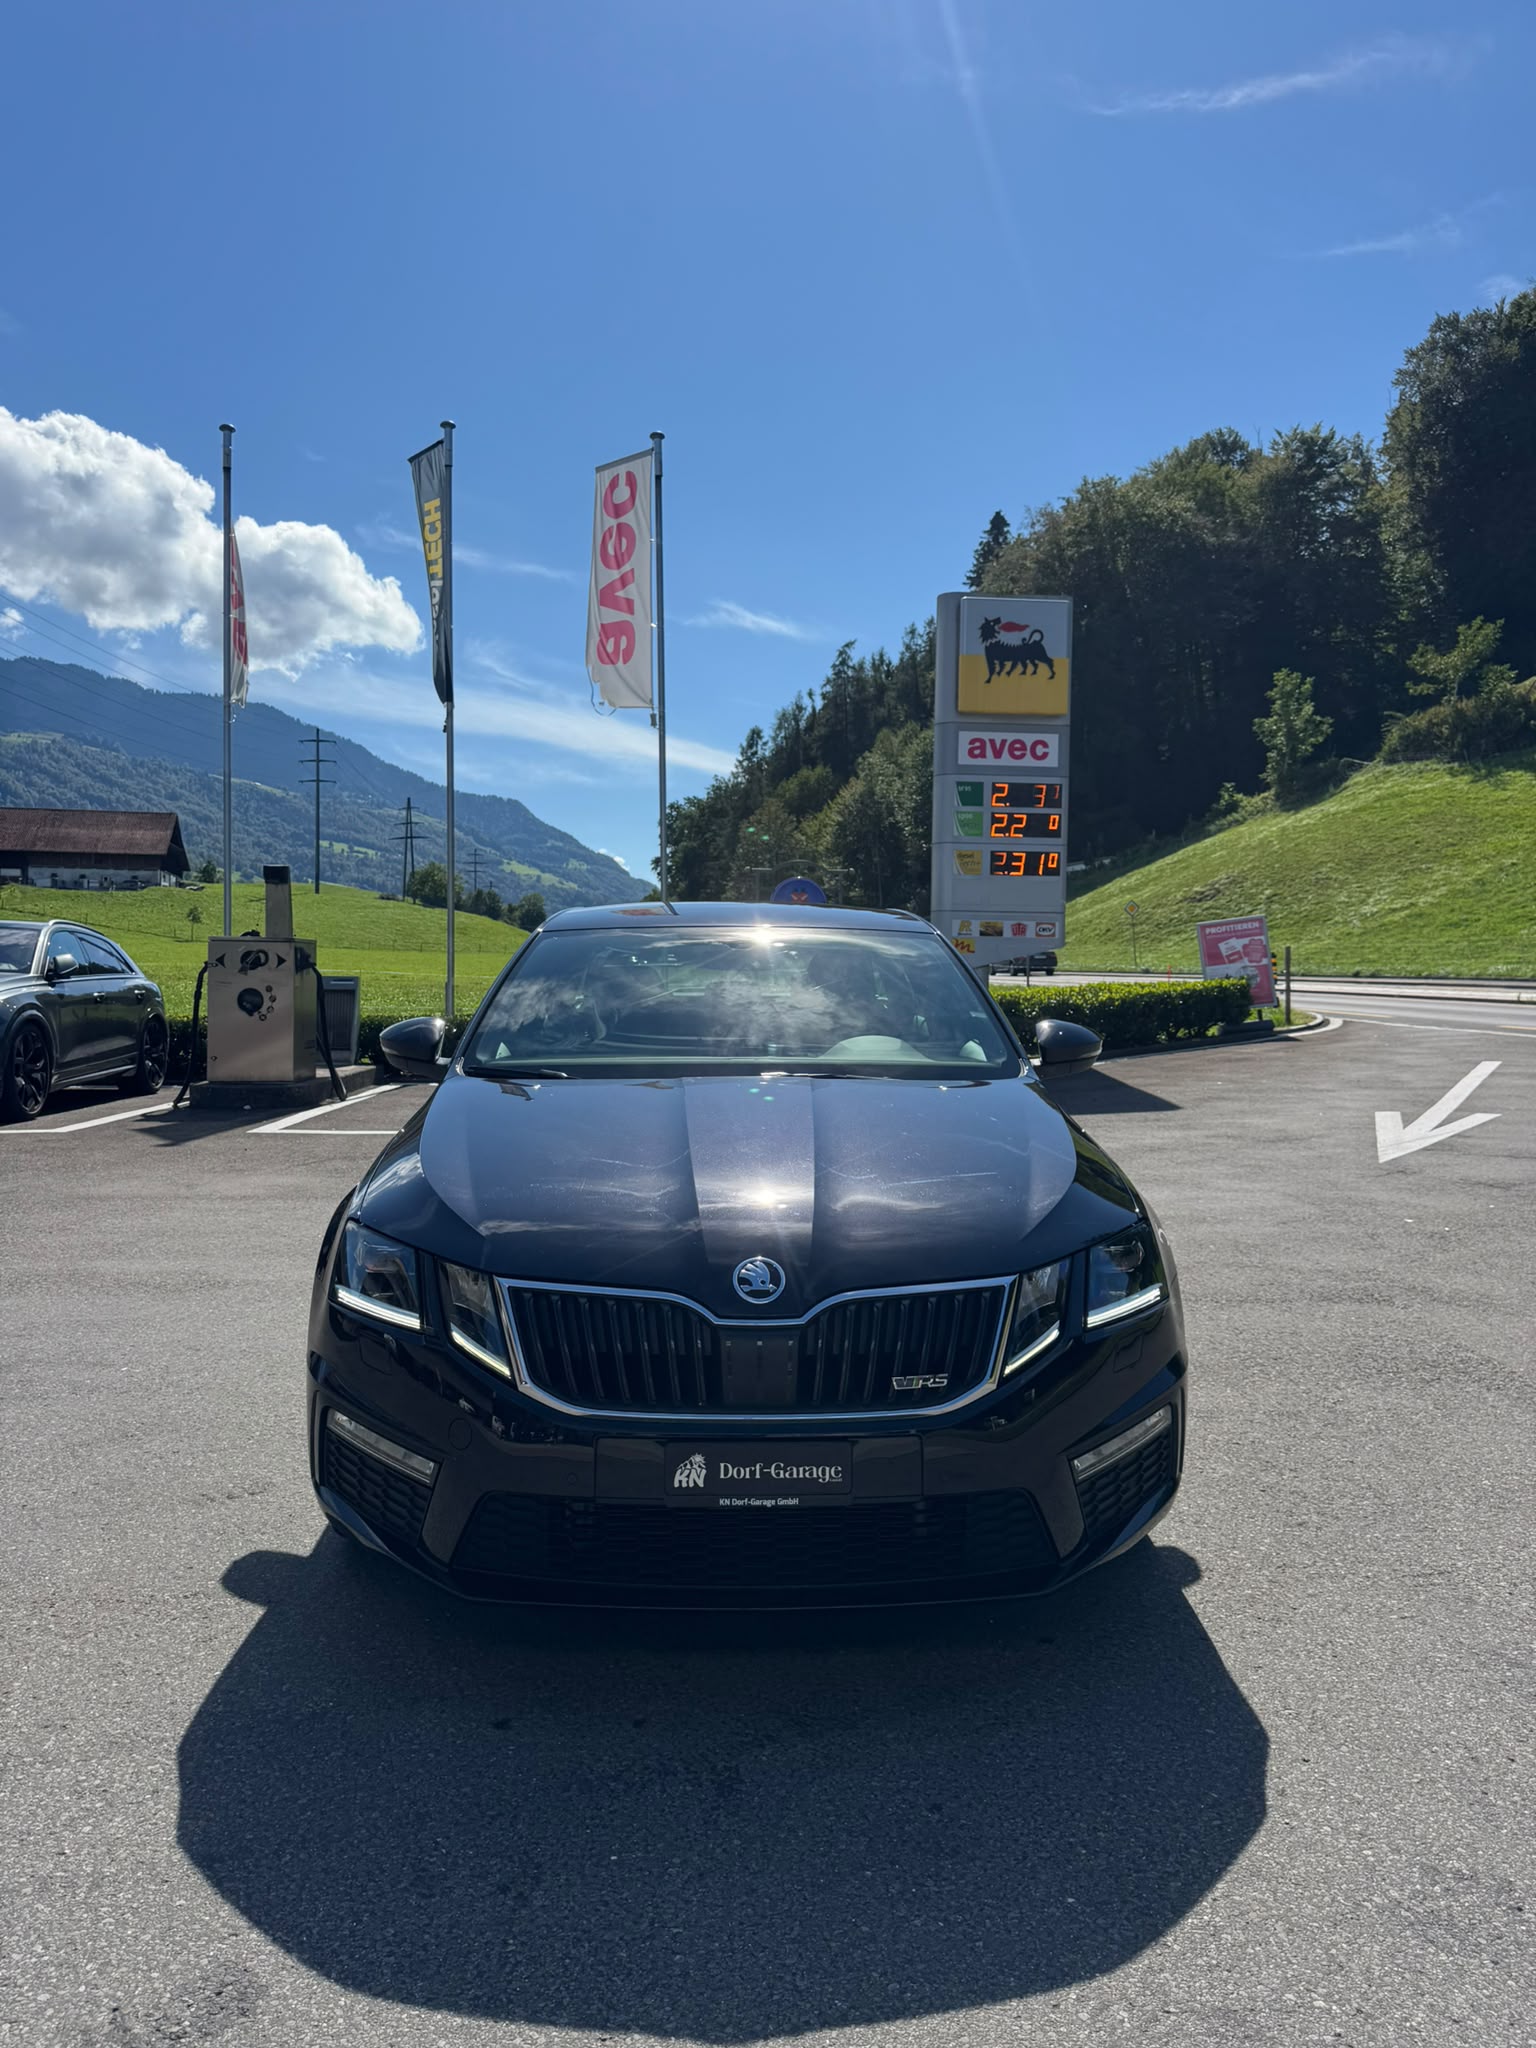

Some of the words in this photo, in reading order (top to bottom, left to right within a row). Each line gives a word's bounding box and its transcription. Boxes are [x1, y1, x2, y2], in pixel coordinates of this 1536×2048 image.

[967, 737, 1049, 761] avec
[1205, 921, 1259, 935] PROFITIEREN
[720, 1462, 843, 1483] Dorf-Garage
[732, 1498, 775, 1507] Dorf-Garage
[777, 1497, 799, 1505] GmbH
